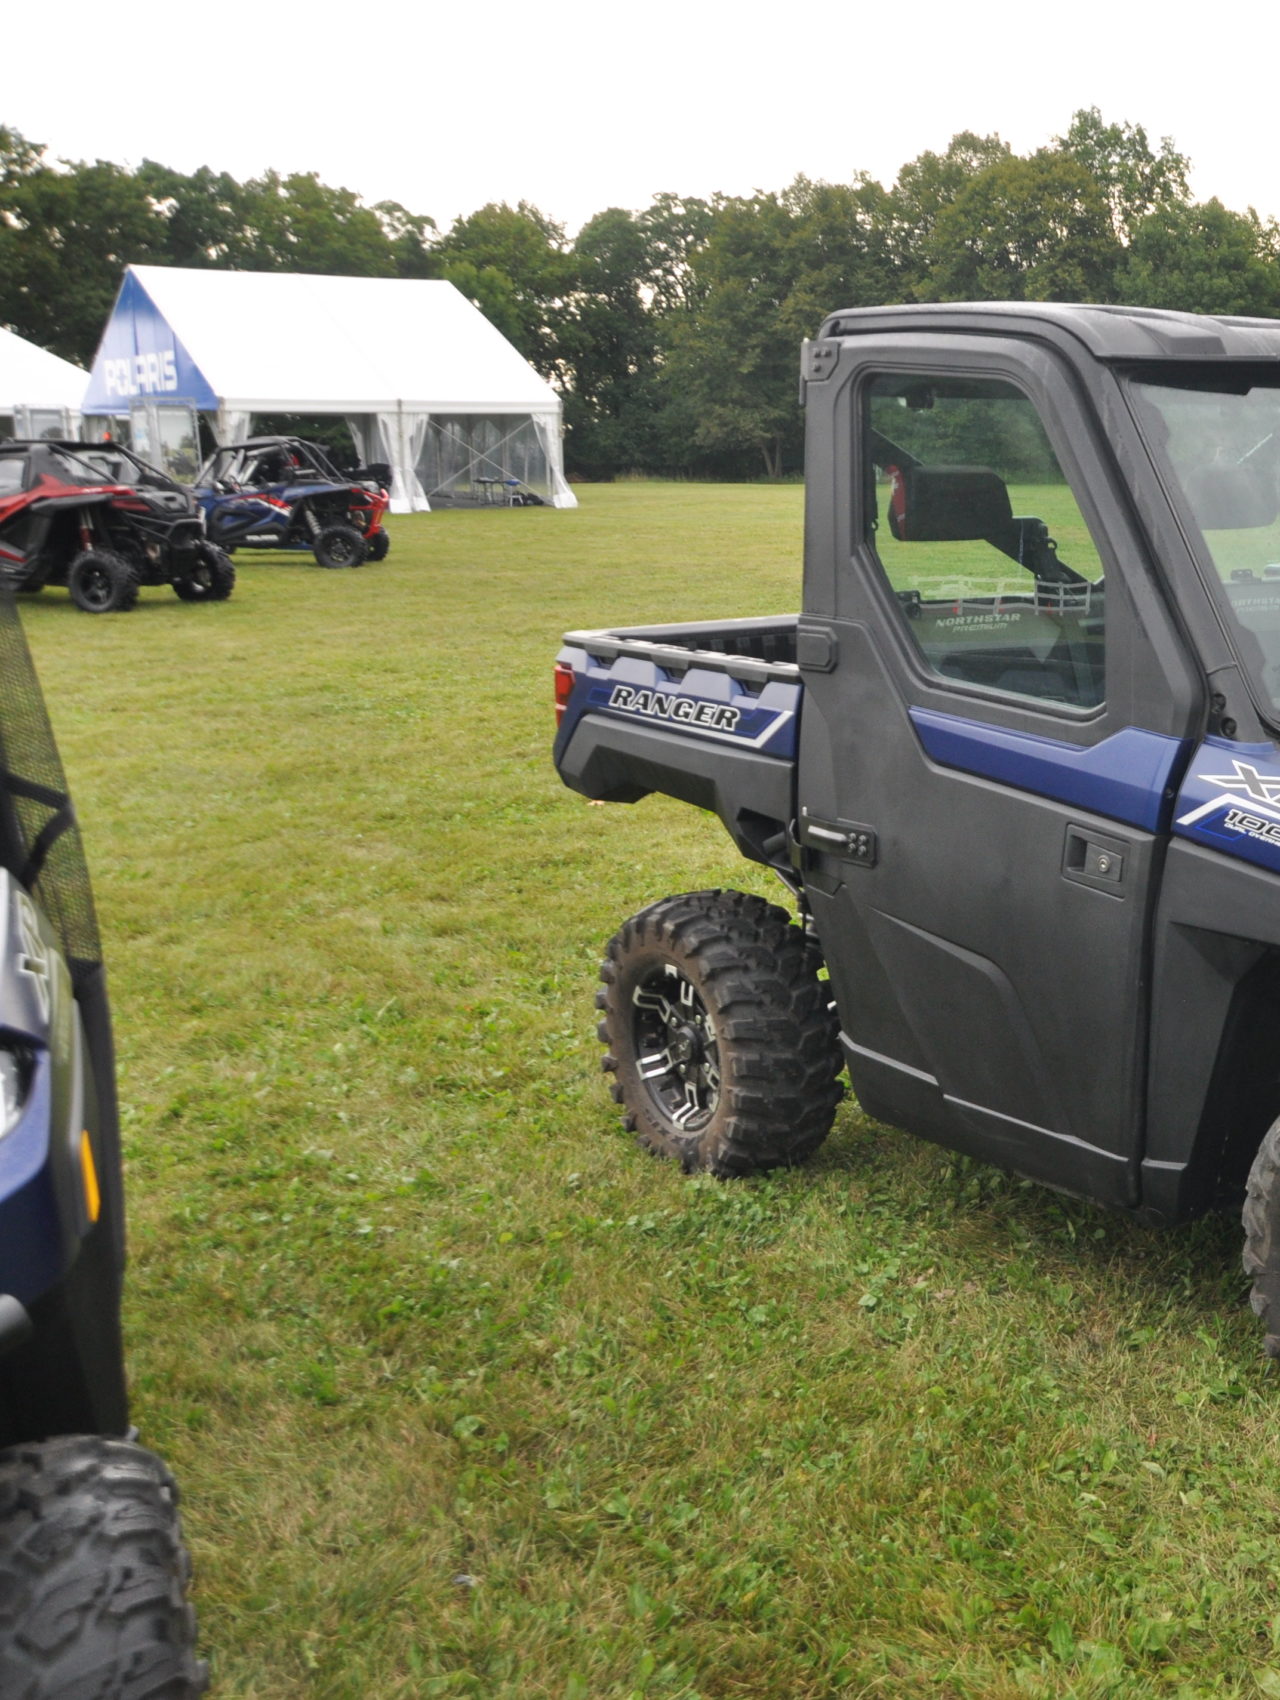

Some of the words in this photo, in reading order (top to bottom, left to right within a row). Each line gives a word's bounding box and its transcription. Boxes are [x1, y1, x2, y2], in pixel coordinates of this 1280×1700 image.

[104, 350, 178, 397] POLARIS
[936, 613, 1021, 628] NORTHSTAR
[952, 622, 1008, 632] PREMIUM
[609, 685, 740, 731] RANGER
